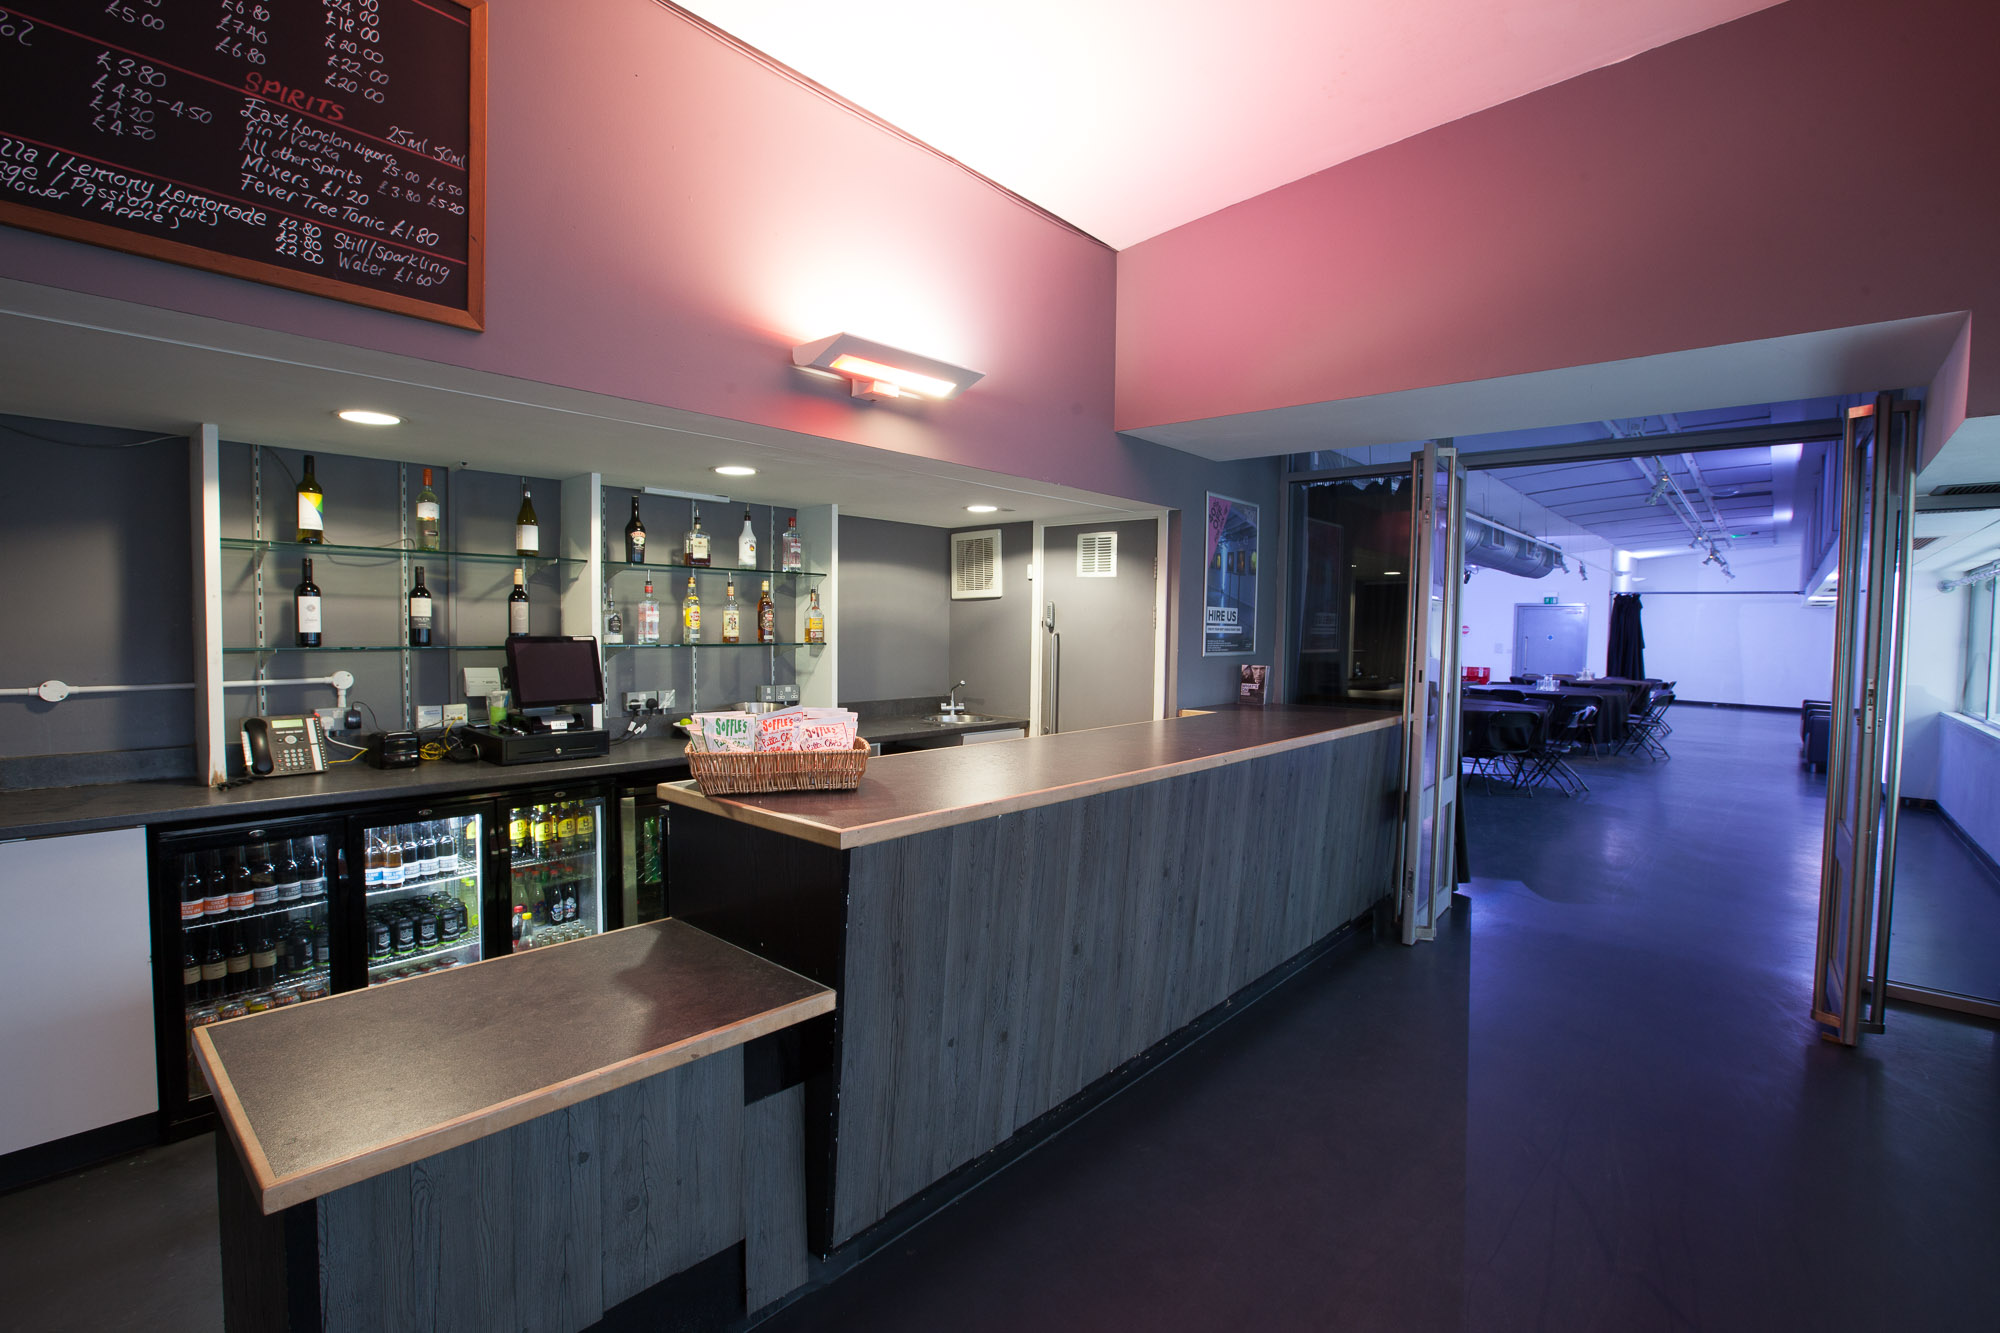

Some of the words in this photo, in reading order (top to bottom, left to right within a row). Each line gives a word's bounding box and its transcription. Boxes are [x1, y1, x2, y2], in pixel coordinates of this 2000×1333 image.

[215, 36, 266, 65] £6.80
[324, 33, 385, 64] £20.00
[327, 54, 390, 85] £22.00
[244, 71, 346, 121] SPIRITS
[324, 72, 386, 104] £20.00
[240, 97, 289, 129] East
[292, 117, 352, 151] London
[354, 142, 386, 163] Liquor
[245, 120, 272, 138] Gin
[238, 136, 267, 157] All
[271, 146, 310, 166] other
[311, 157, 363, 185] Spirits
[427, 195, 465, 215] £5.20
[241, 154, 310, 189] Mixers
[321, 180, 370, 206] £1.20
[382, 164, 420, 184] £5.00
[427, 177, 463, 196] £6.50
[61, 156, 154, 199] Lemony
[159, 183, 267, 226] Lemonade
[277, 217, 322, 239] £2.80
[241, 172, 299, 202] Fever
[301, 193, 337, 217] Tree
[342, 205, 386, 231] Tonic
[390, 220, 439, 247] £1.80
[275, 230, 323, 252] £2.80
[275, 243, 325, 264] £2.00
[338, 252, 386, 277] Water
[393, 267, 432, 286] £1.60
[1208, 610, 1225, 622] HIRE
[1226, 611, 1237, 622] US
